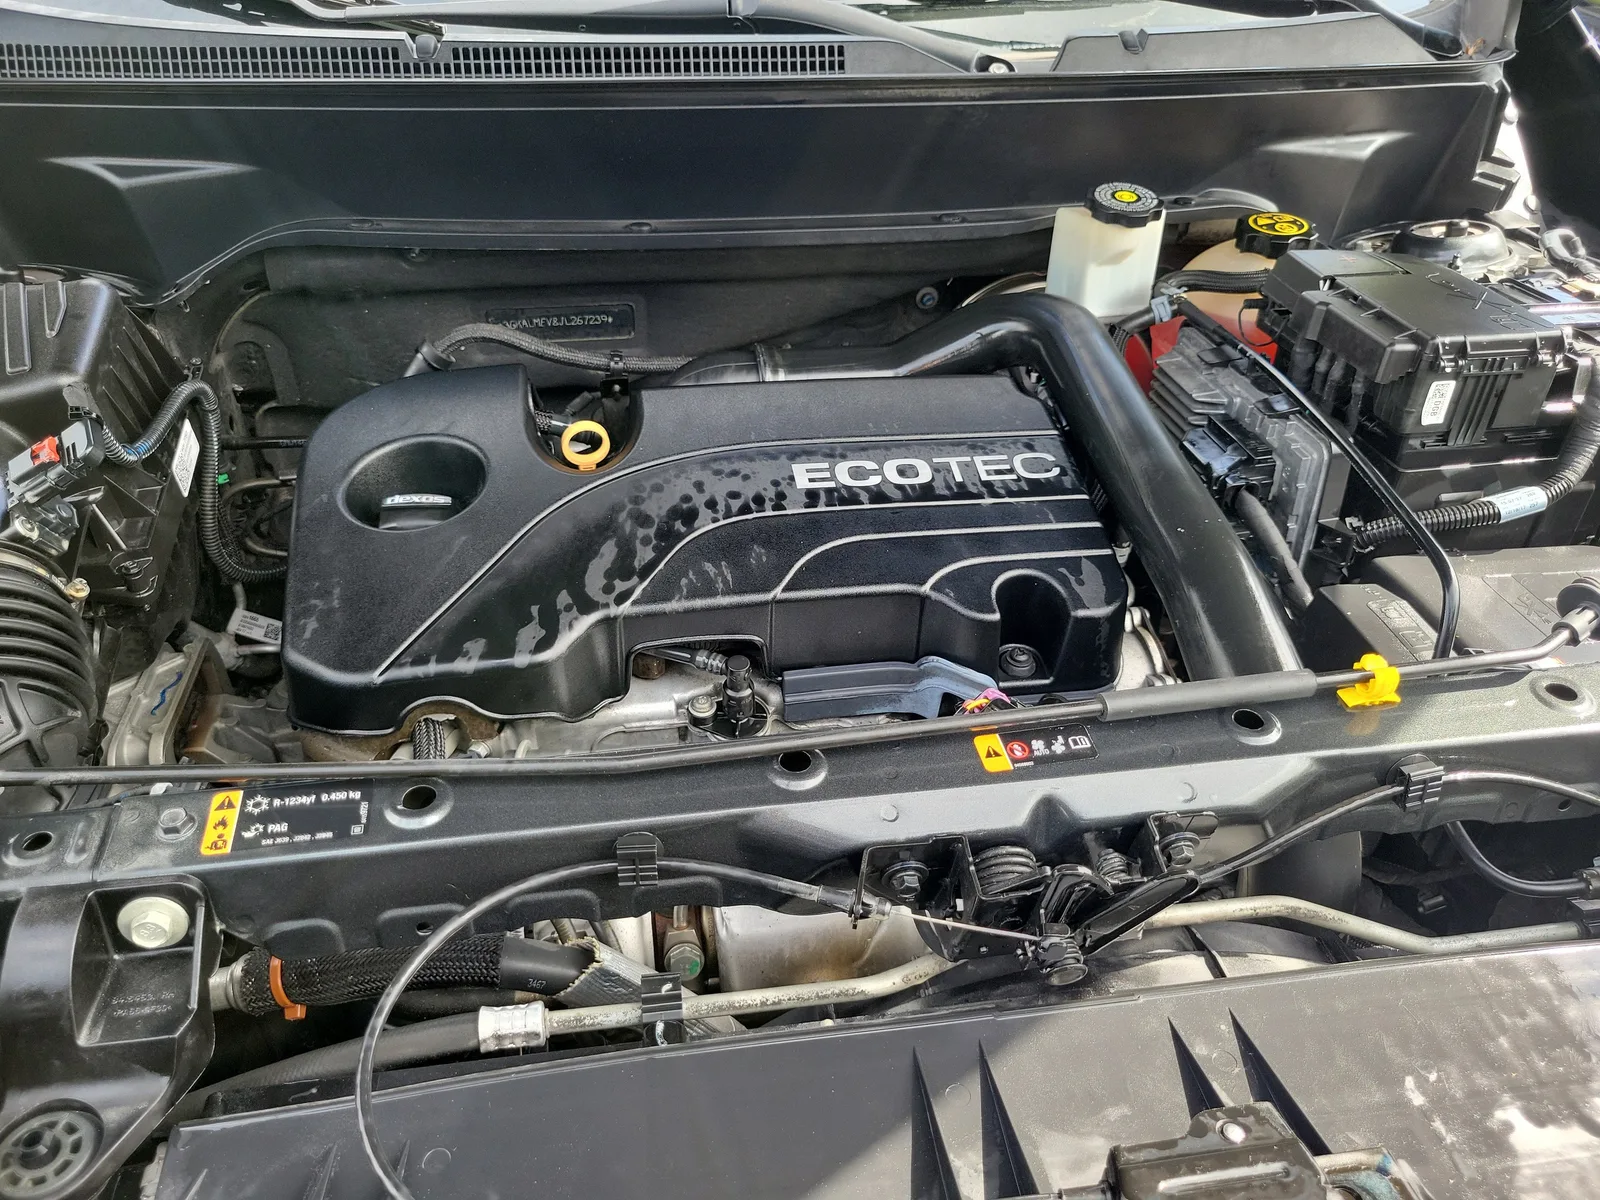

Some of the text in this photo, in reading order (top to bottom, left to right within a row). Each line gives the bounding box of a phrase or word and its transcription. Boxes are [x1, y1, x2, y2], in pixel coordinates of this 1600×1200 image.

[790, 452, 1061, 489] ECOTEC
[386, 494, 446, 505] dexos
[1033, 748, 1050, 757] AUTO
[273, 789, 361, 808] R-1234yf 0.450 kg
[267, 822, 289, 835] PAG
[527, 978, 547, 989] 3467
